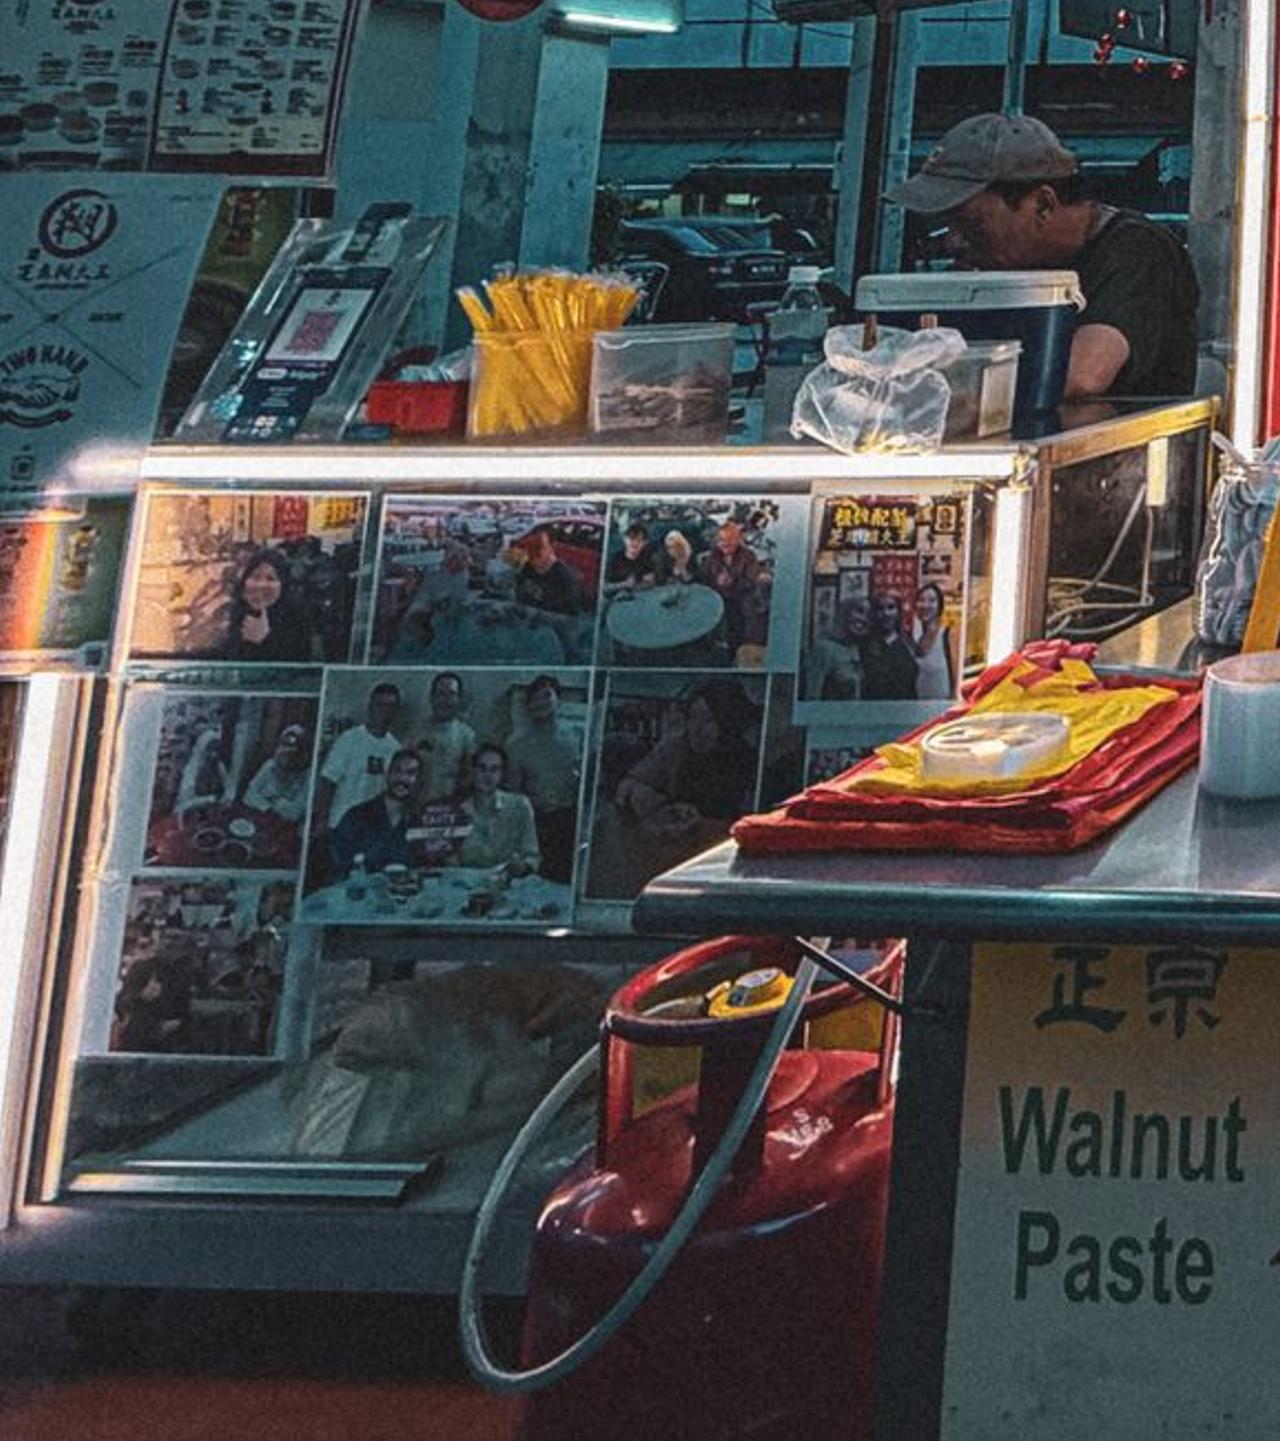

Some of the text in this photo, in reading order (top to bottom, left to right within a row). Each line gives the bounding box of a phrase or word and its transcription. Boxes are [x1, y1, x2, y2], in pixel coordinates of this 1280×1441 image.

[1032, 944, 1230, 1040] 正宗
[999, 1084, 1248, 1185] Walnut
[1013, 1209, 1216, 1307] Paste
